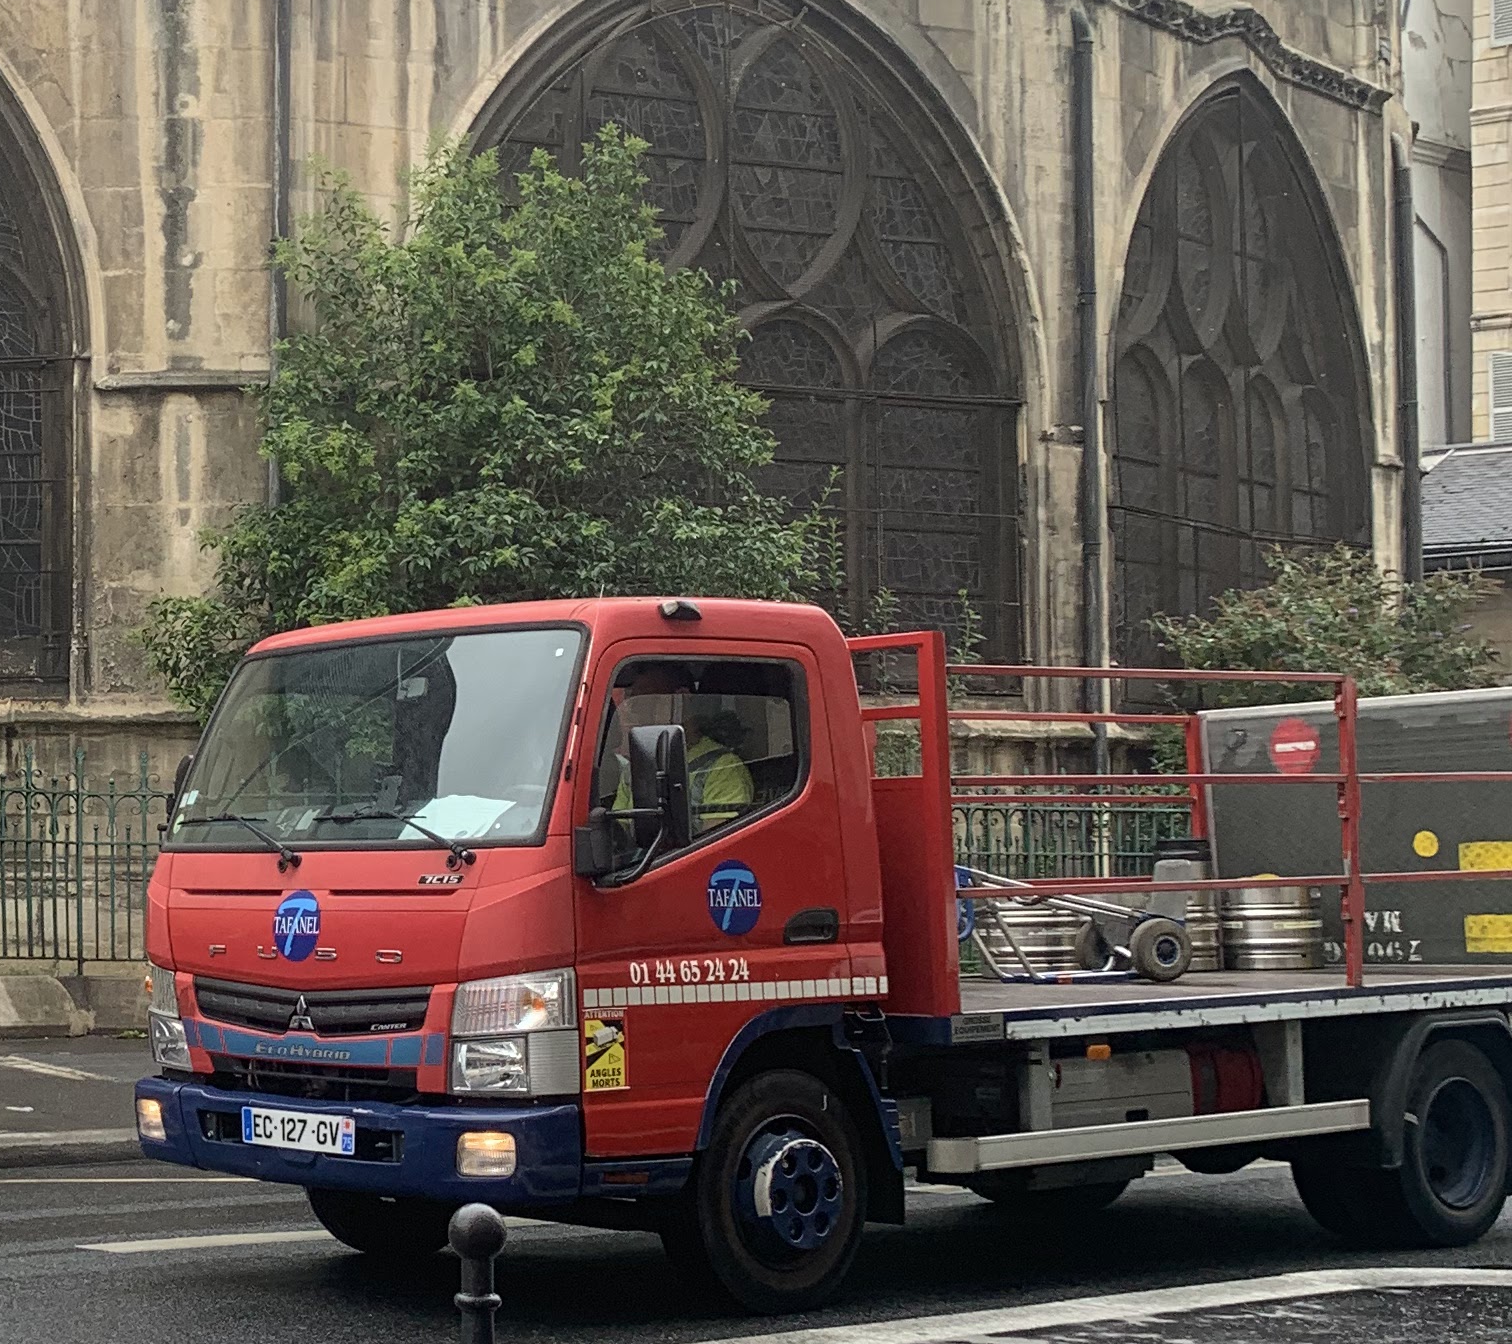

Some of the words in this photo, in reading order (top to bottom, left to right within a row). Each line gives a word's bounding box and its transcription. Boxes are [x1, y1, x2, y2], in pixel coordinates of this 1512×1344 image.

[708, 888, 761, 907] TAFANEL
[274, 916, 320, 935] TAFANEL
[209, 944, 403, 963] FUSO
[629, 961, 651, 985] 01
[655, 959, 676, 983] 44
[680, 959, 701, 983] 65
[703, 957, 726, 982] 24
[728, 956, 750, 981] 24
[584, 1009, 624, 1019] ATTENTION
[590, 1067, 622, 1078] ANGLES
[592, 1078, 621, 1088] MORTS
[342, 1137, 352, 1149] 75
